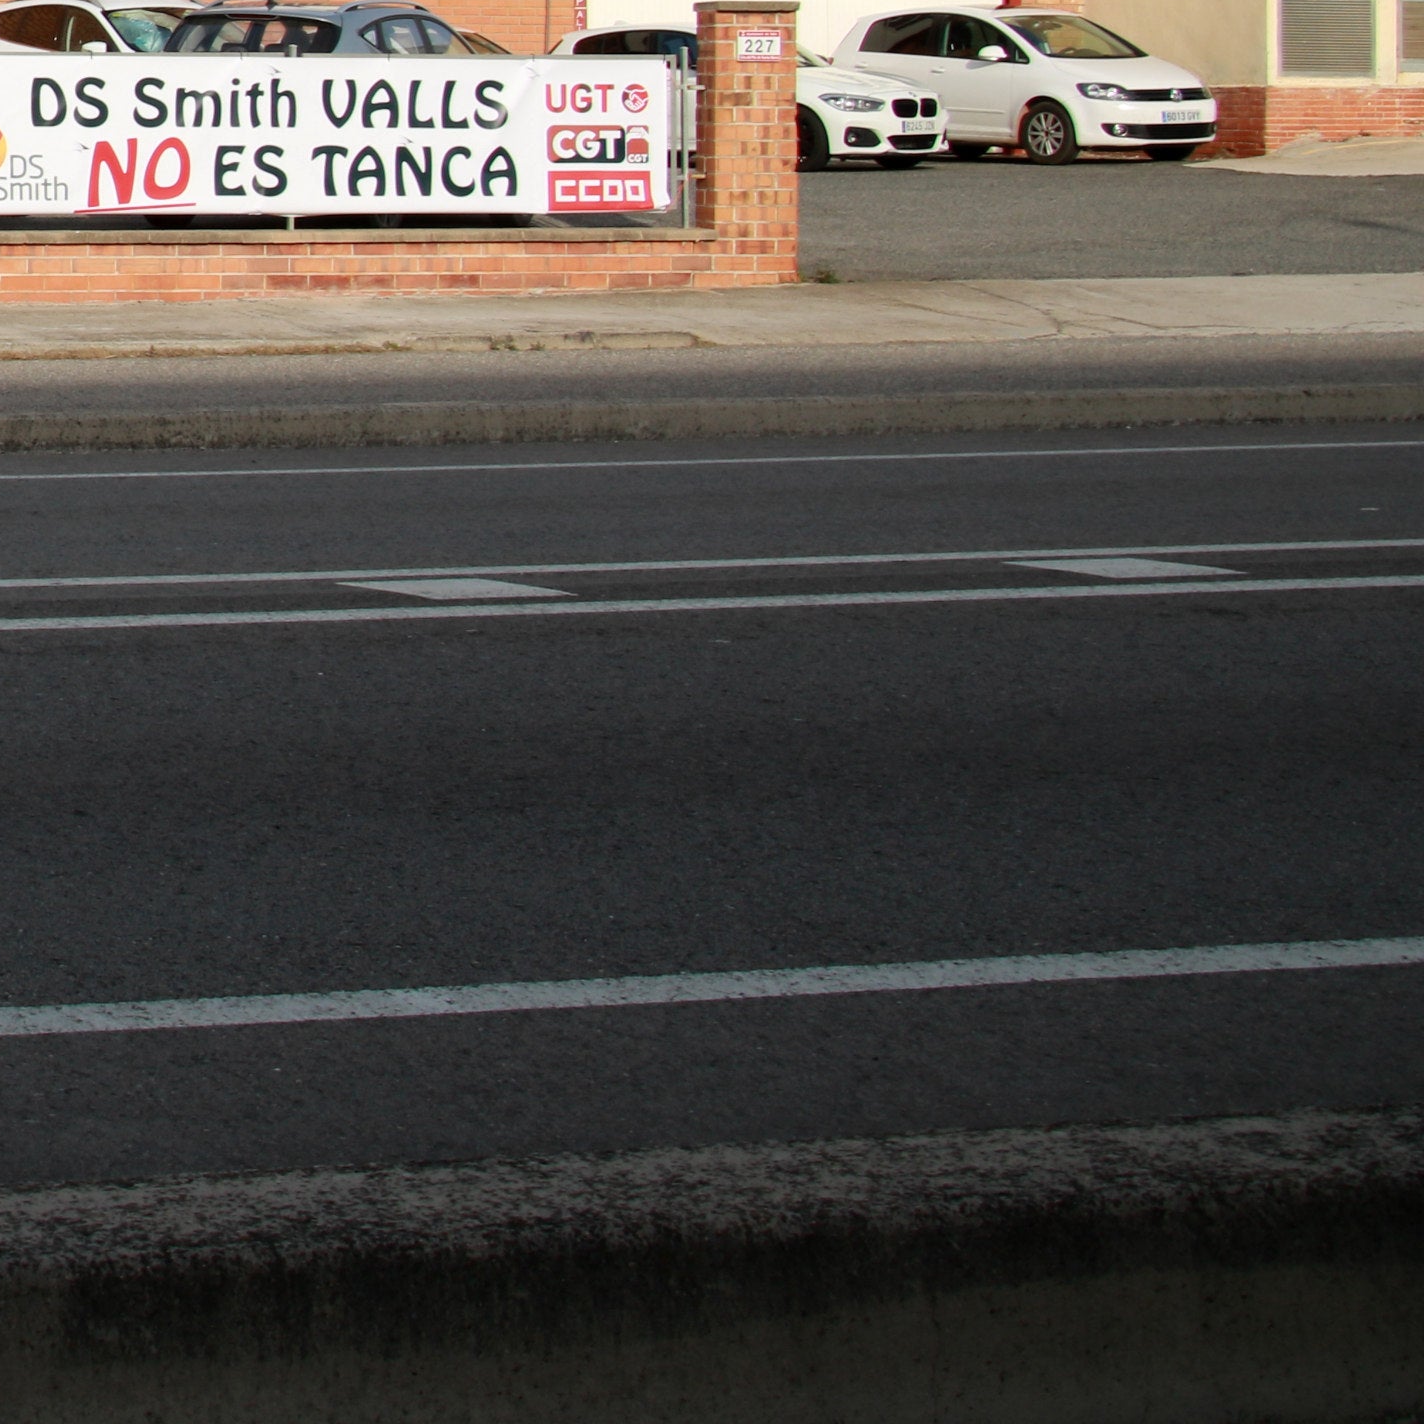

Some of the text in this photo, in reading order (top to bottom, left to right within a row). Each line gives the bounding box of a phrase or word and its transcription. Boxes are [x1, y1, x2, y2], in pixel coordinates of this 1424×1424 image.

[744, 39, 774, 53] 227
[30, 76, 509, 130] DS Smith VALLS
[545, 83, 615, 113] UGT
[552, 129, 622, 160] CGT
[627, 153, 648, 163] CGT
[9, 154, 44, 179] DS
[88, 137, 518, 208] NO ES TANCA
